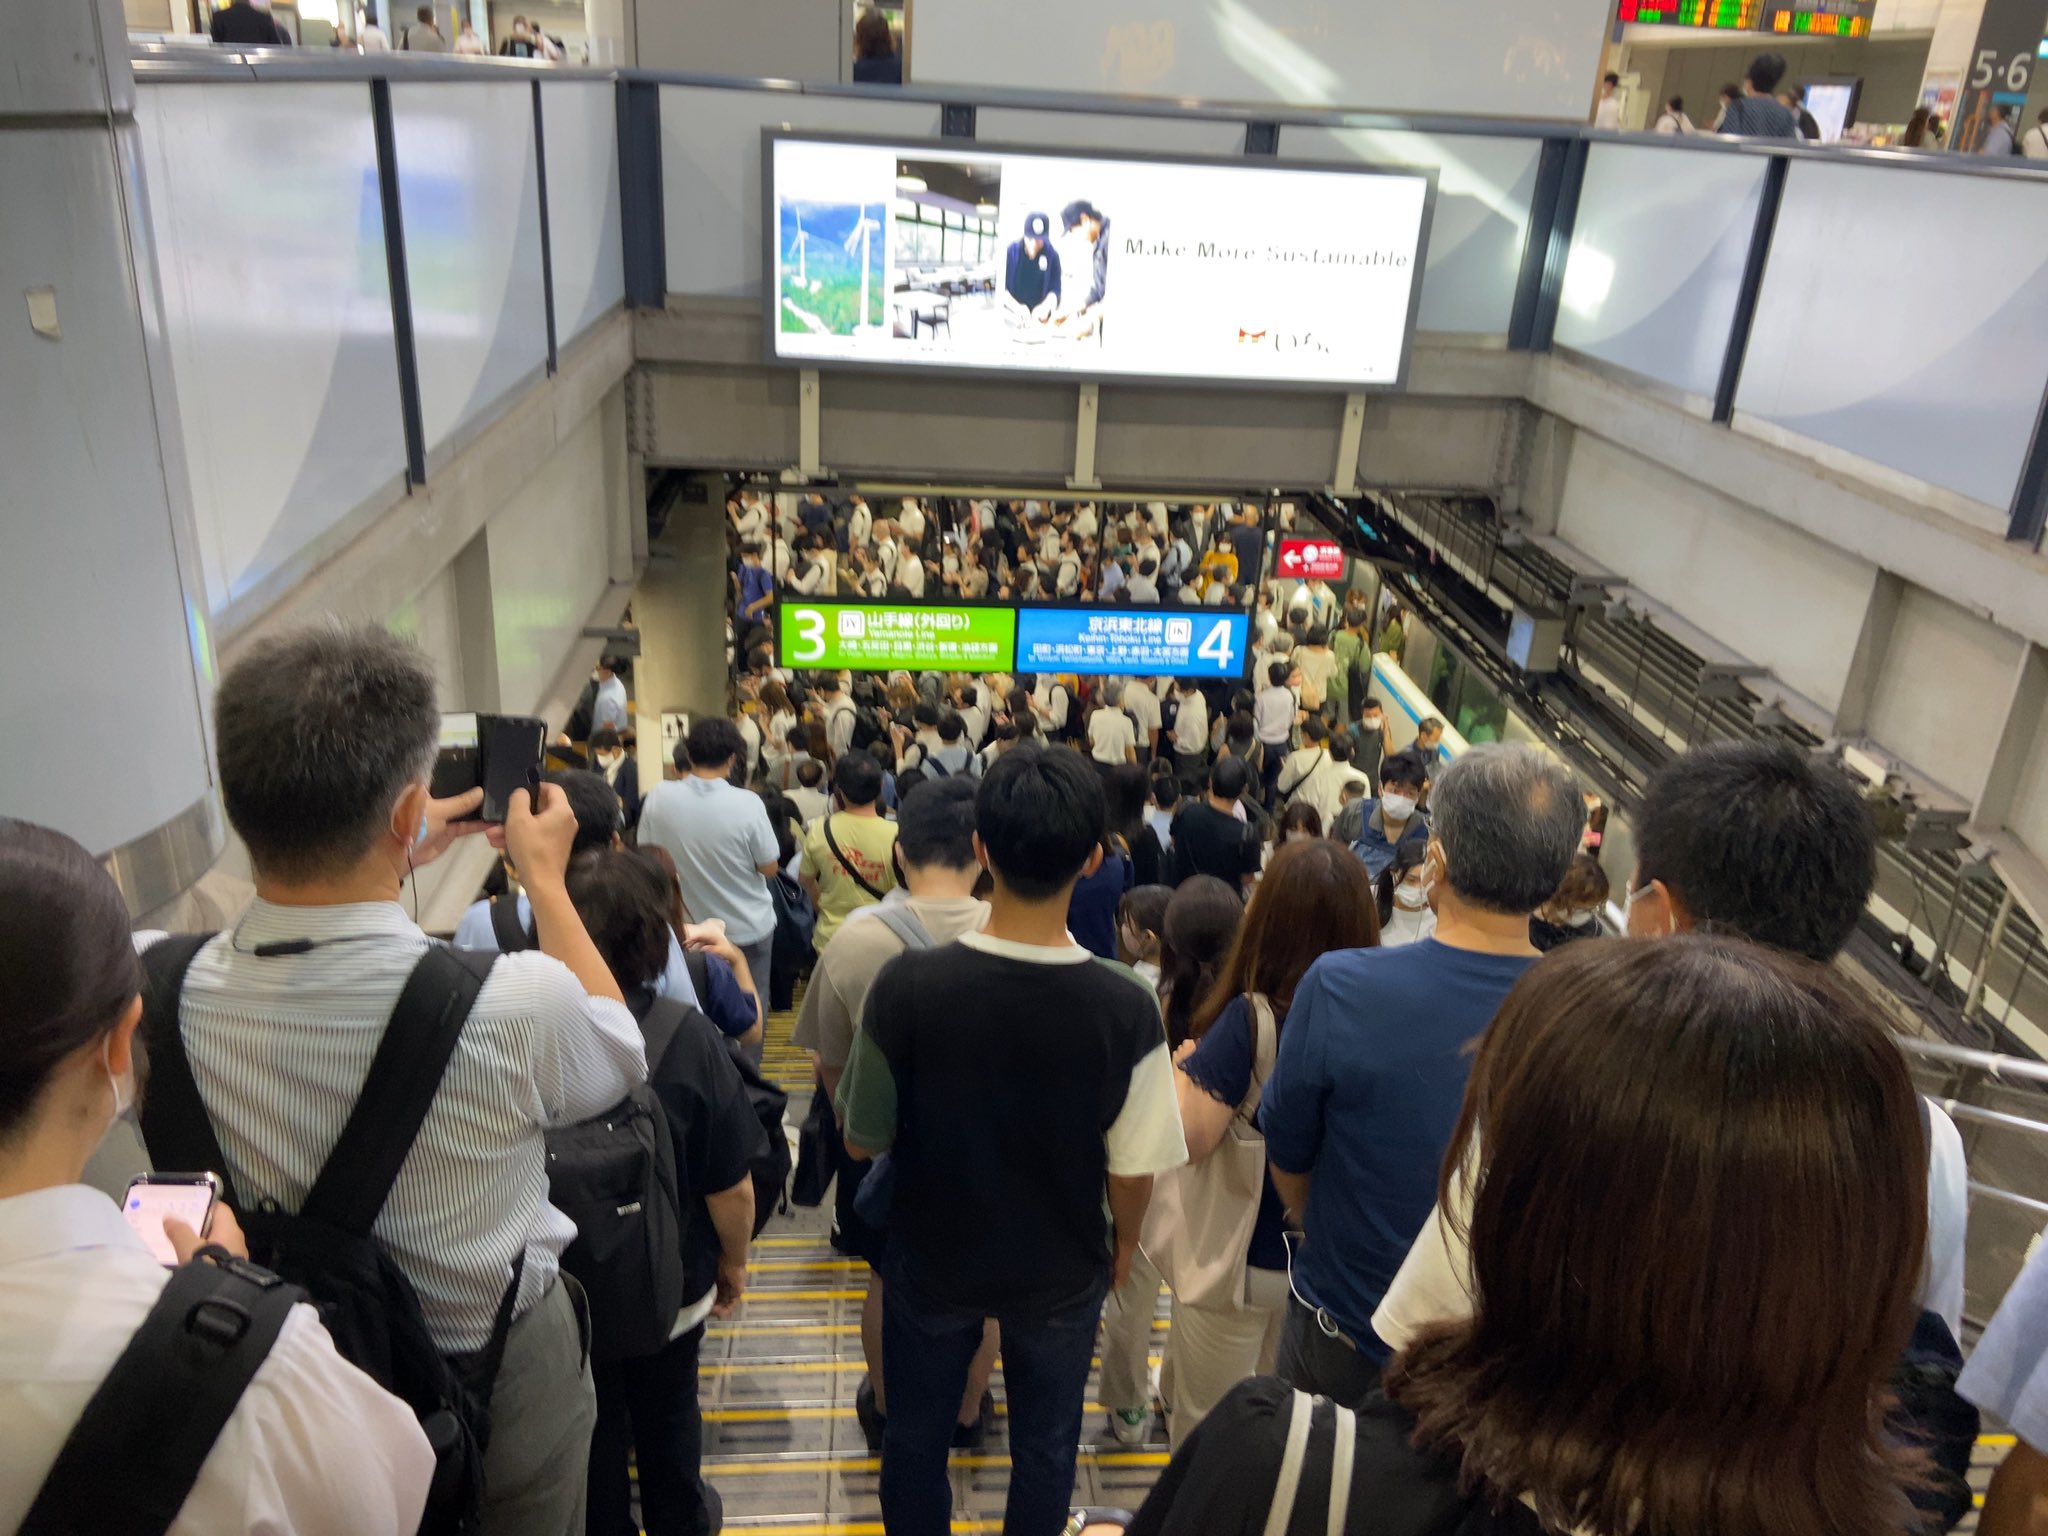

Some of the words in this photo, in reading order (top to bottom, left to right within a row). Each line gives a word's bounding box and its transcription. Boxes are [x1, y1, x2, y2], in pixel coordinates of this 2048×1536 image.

[1126, 238, 1186, 257] Make
[1198, 242, 1255, 260] More
[1267, 246, 1407, 267] Sustainable
[793, 609, 826, 662] 3
[868, 629, 913, 639] Yamanote
[915, 630, 935, 640] Line
[1088, 616, 1162, 634] 京浜東北線
[1143, 633, 1162, 645] Line
[1197, 619, 1234, 670] 4
